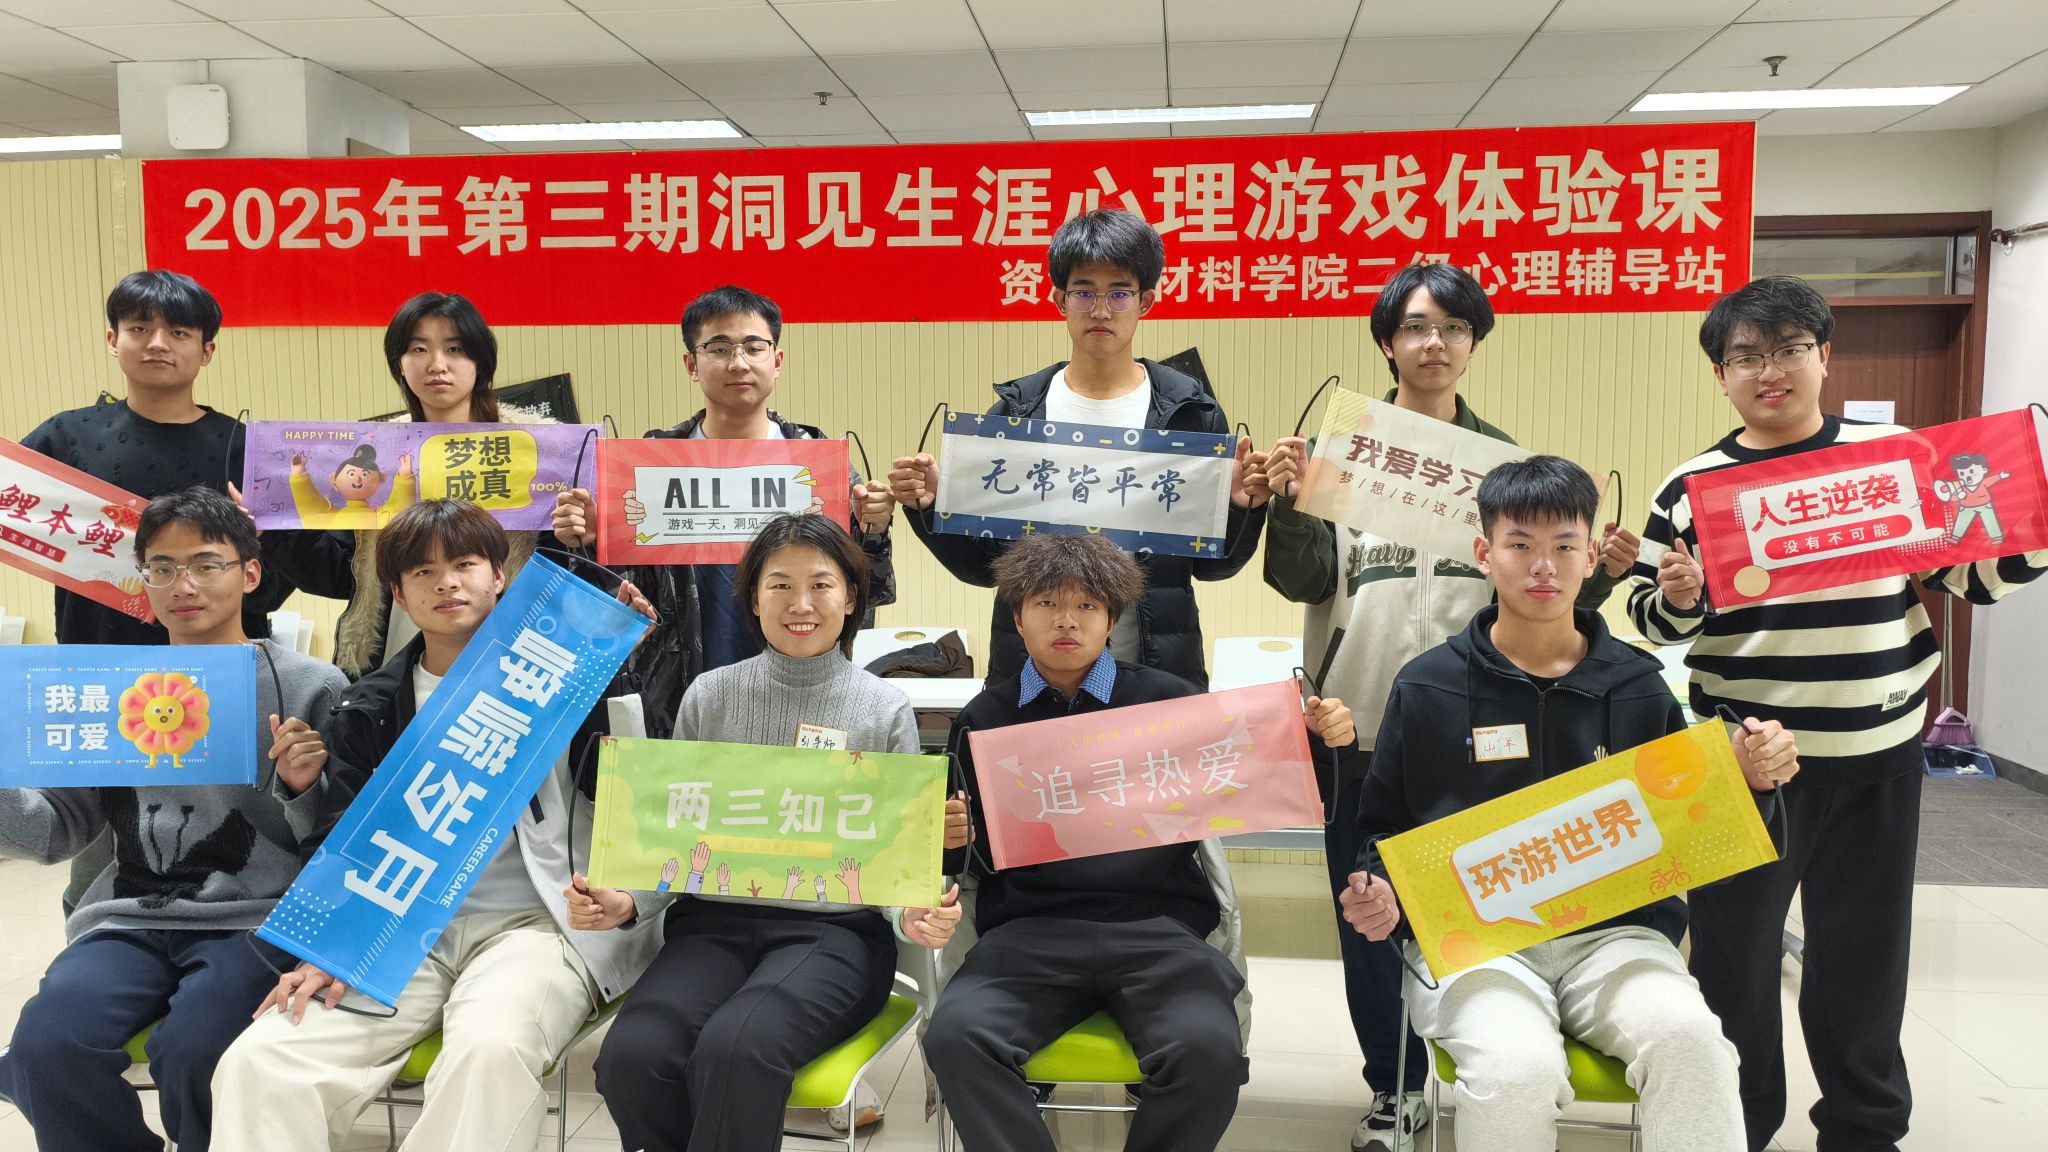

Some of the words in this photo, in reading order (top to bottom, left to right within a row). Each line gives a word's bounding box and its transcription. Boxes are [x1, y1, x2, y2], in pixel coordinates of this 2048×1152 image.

[185, 148, 1722, 257] 2025年第三期洞见生涯心理游戏体验课
[1001, 246, 1727, 305] 资材料学院二心理辅导站
[285, 431, 323, 440] HAPPY
[328, 431, 355, 440] TIME
[444, 436, 511, 469] 梦想
[446, 469, 511, 502] 成真
[530, 482, 568, 491] 100%
[981, 459, 1186, 512] 无常皆平常
[1345, 434, 1487, 502] 我爱学习
[664, 477, 730, 509] ALL
[751, 477, 787, 508] IN
[1751, 473, 1901, 533] 人生逆袭
[1783, 523, 1889, 555] 没有不可能
[44, 684, 110, 714] 我最
[44, 722, 109, 751] 可爱
[343, 627, 581, 919] 峥嵘岁月
[1031, 737, 1249, 819] 追寻热爱
[667, 781, 876, 840] 两三知己
[468, 827, 499, 873] CAREER
[1467, 798, 1641, 900] 环游世界
[441, 871, 469, 908] GAME
